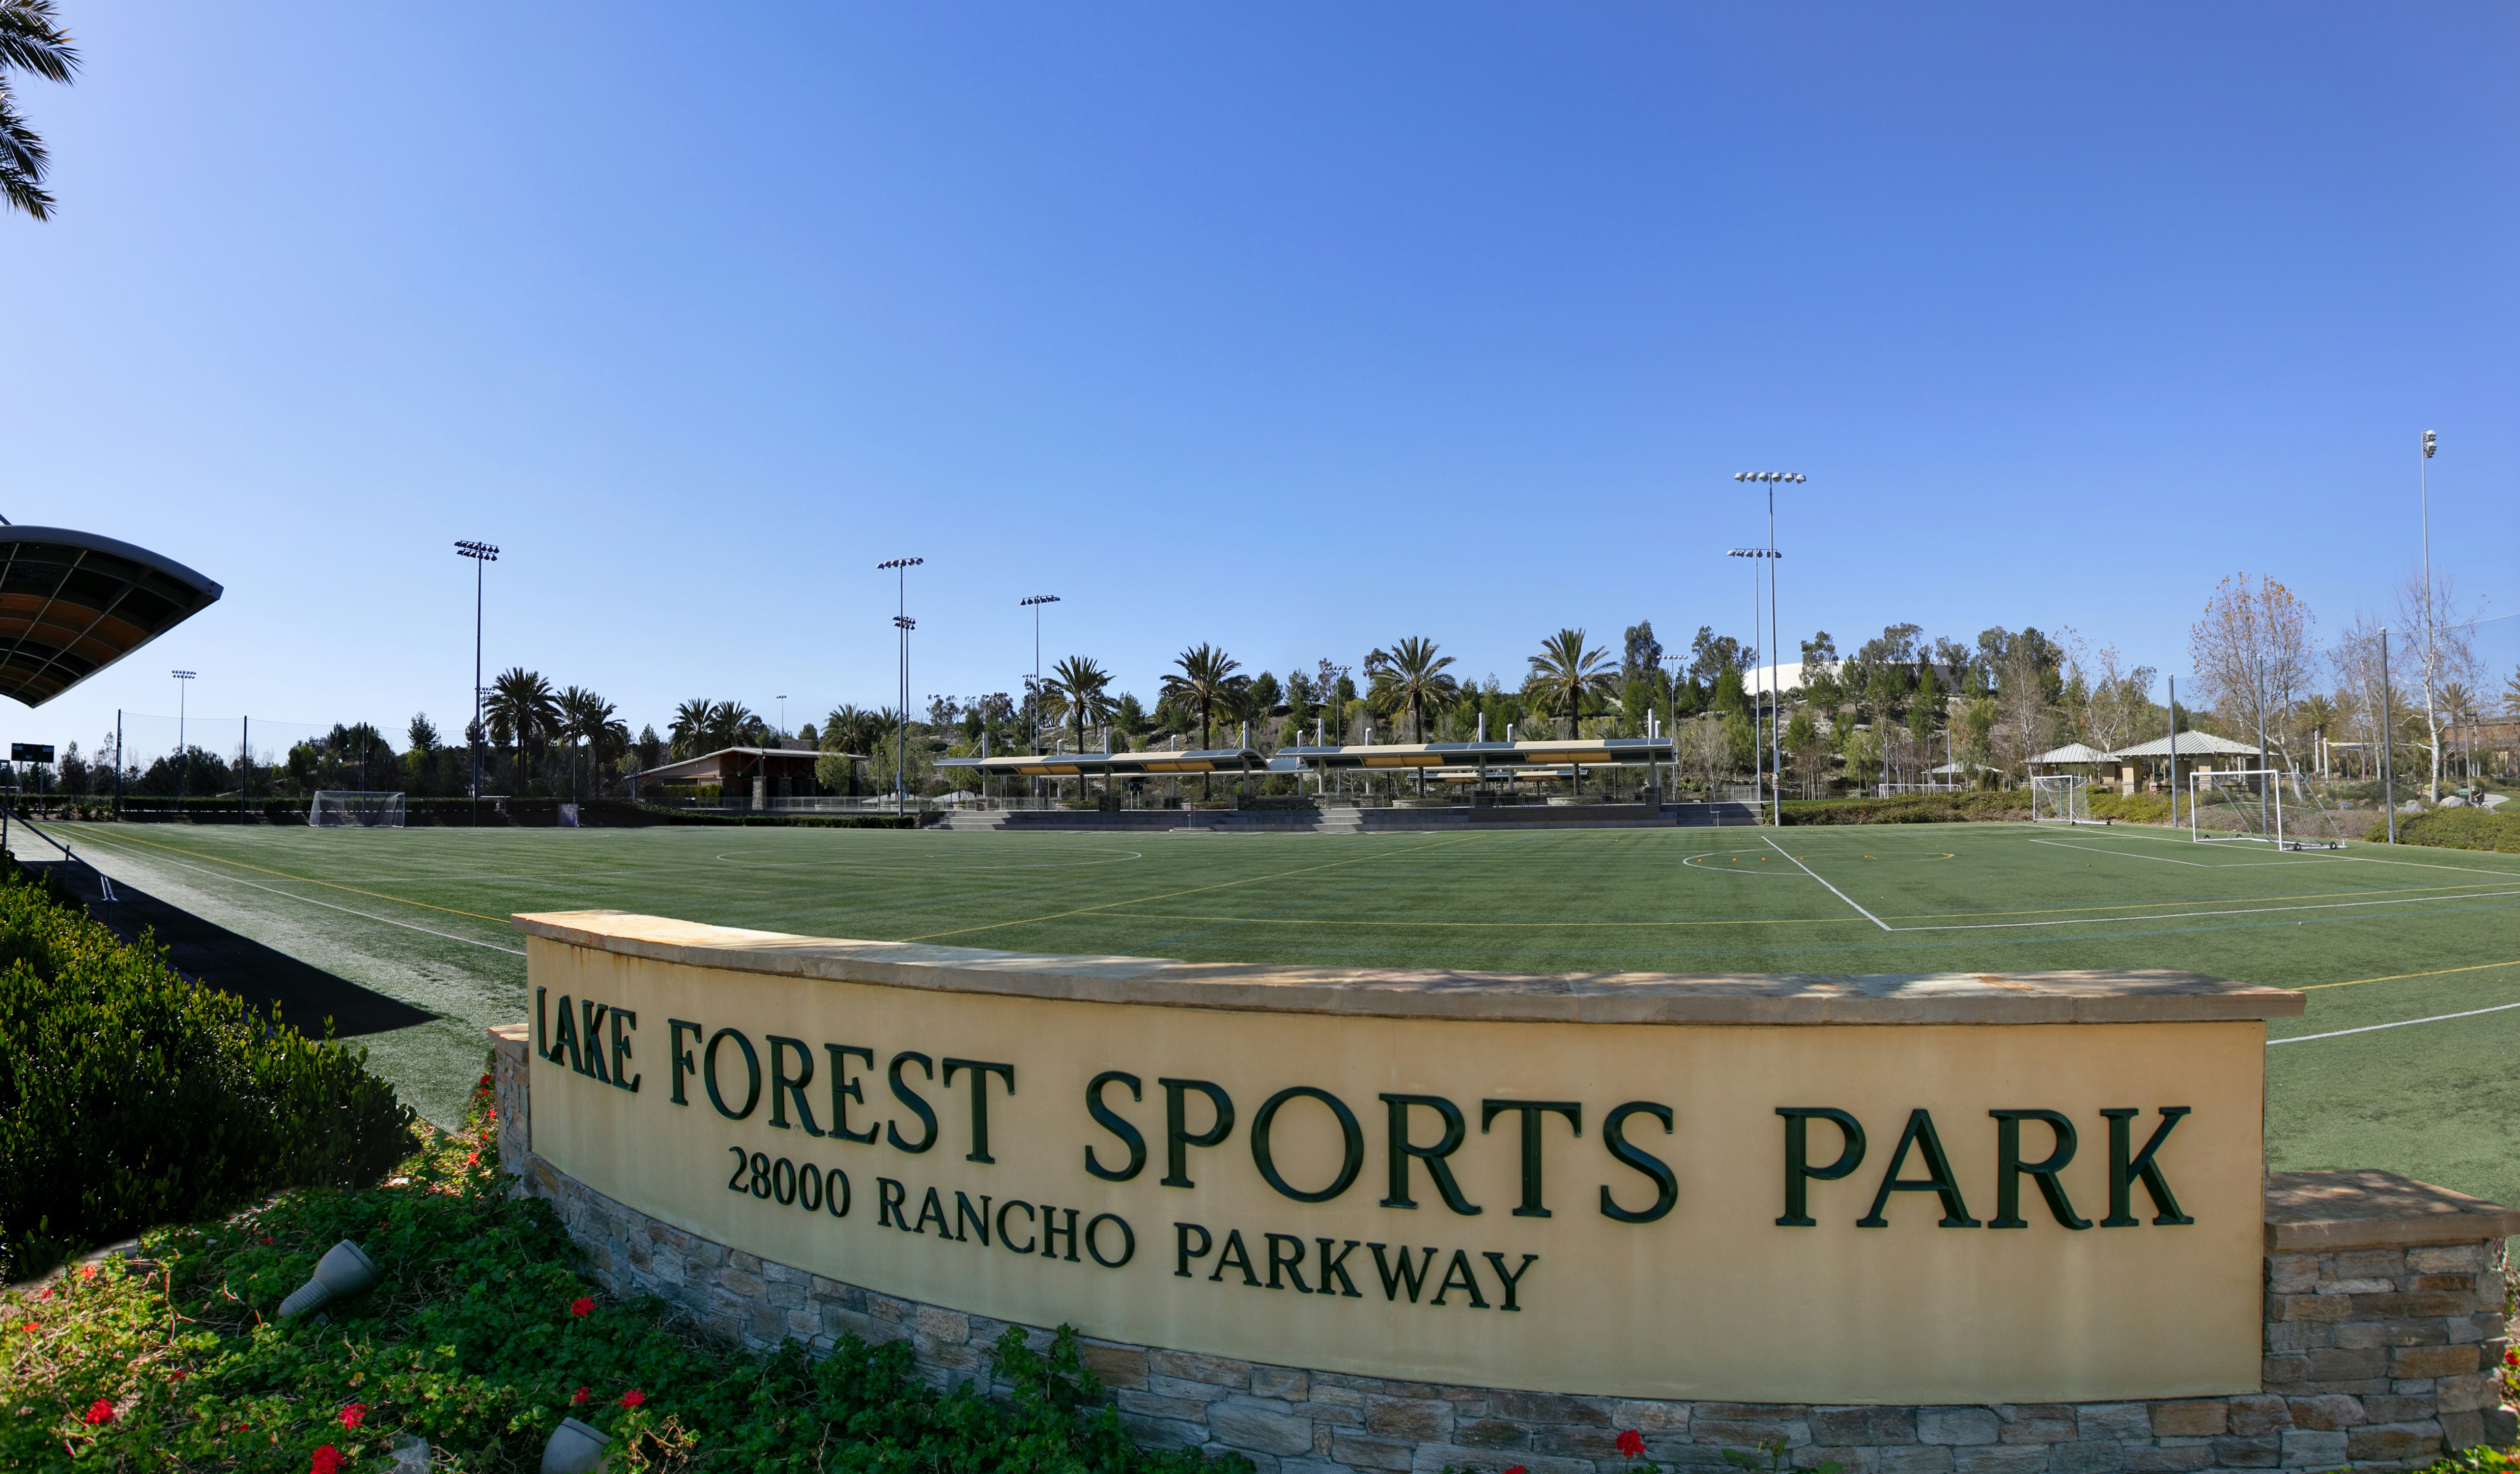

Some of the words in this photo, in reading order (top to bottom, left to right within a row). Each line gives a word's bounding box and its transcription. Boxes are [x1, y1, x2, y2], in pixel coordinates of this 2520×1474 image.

[537, 986, 641, 1094] LAKE
[667, 1018, 1015, 1165] FOREST
[1085, 1070, 1679, 1224] SPORTS
[1775, 1106, 2195, 1231] PARK
[728, 1146, 851, 1218] 28000
[876, 1177, 1136, 1269] RANCHO
[1174, 1222, 1539, 1312] PARKWAY
